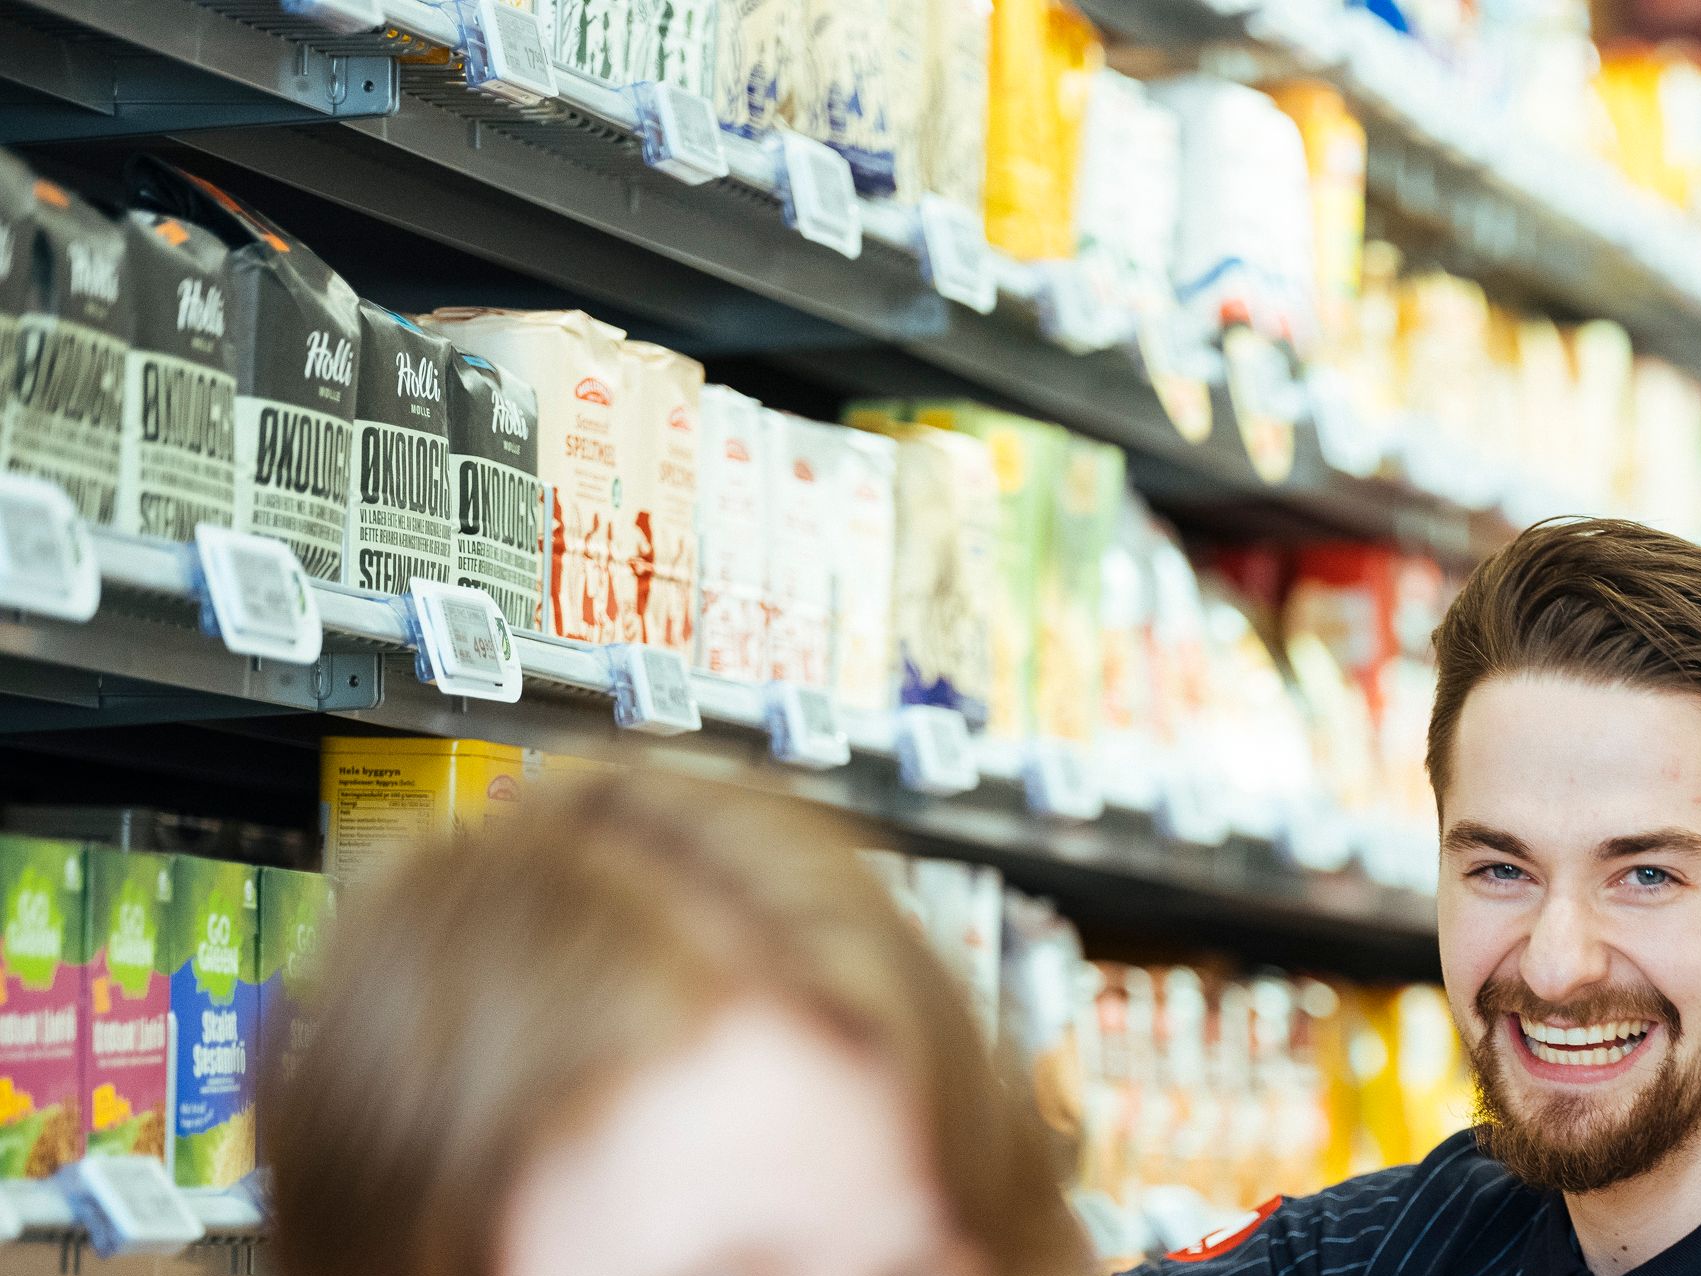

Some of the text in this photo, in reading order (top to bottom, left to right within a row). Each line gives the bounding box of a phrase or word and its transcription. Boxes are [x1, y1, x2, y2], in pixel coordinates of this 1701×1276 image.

[305, 330, 354, 387] Holli
[396, 351, 441, 403] Holli
[410, 403, 431, 419] MØLLE
[490, 389, 530, 441] Holli
[360, 508, 368, 524] VI
[369, 509, 387, 527] LAGER
[360, 526, 379, 544] DETTE
[458, 539, 466, 555] VI
[458, 556, 478, 573] DETTE
[207, 912, 231, 946] GO
